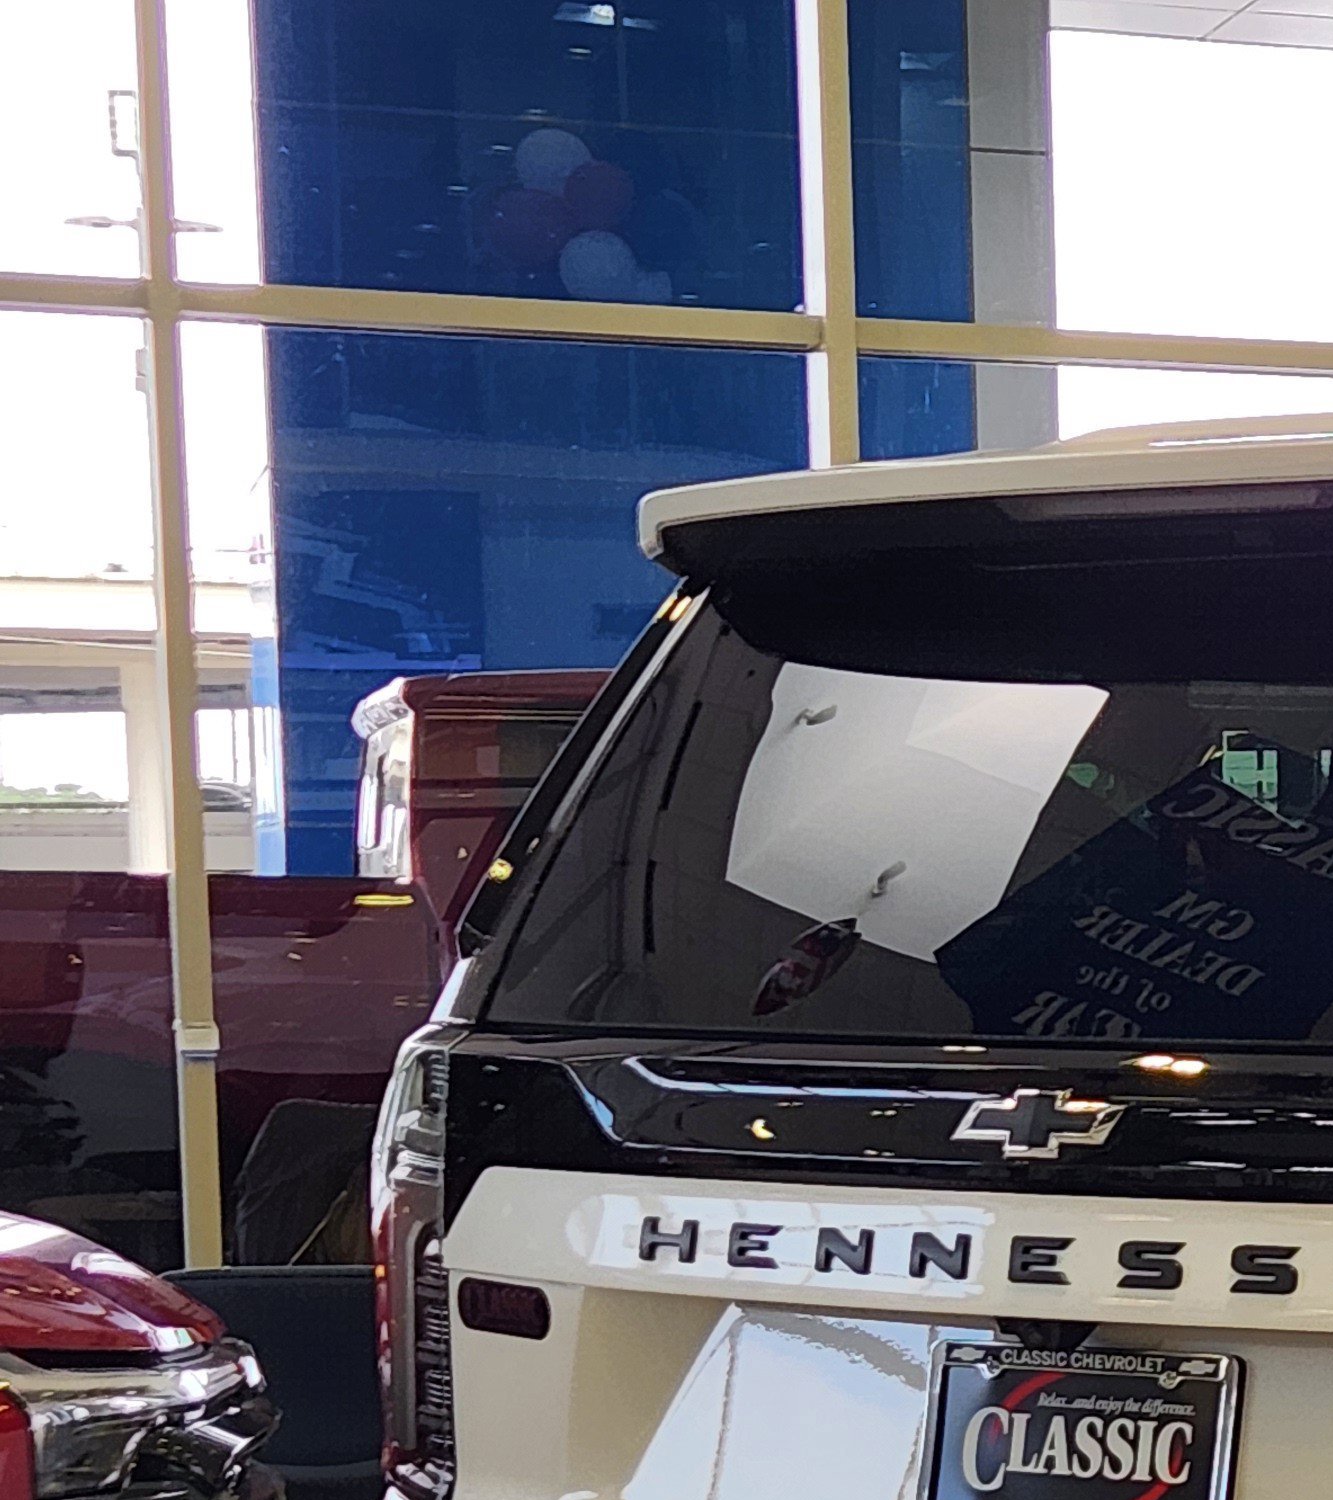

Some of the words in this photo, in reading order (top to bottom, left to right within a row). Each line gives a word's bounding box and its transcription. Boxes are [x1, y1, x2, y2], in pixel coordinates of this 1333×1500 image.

[1001, 1348, 1067, 1367] CLASSIC
[1070, 1352, 1165, 1373] CHEVROLET
[962, 1406, 1194, 1492] CLASSIC
